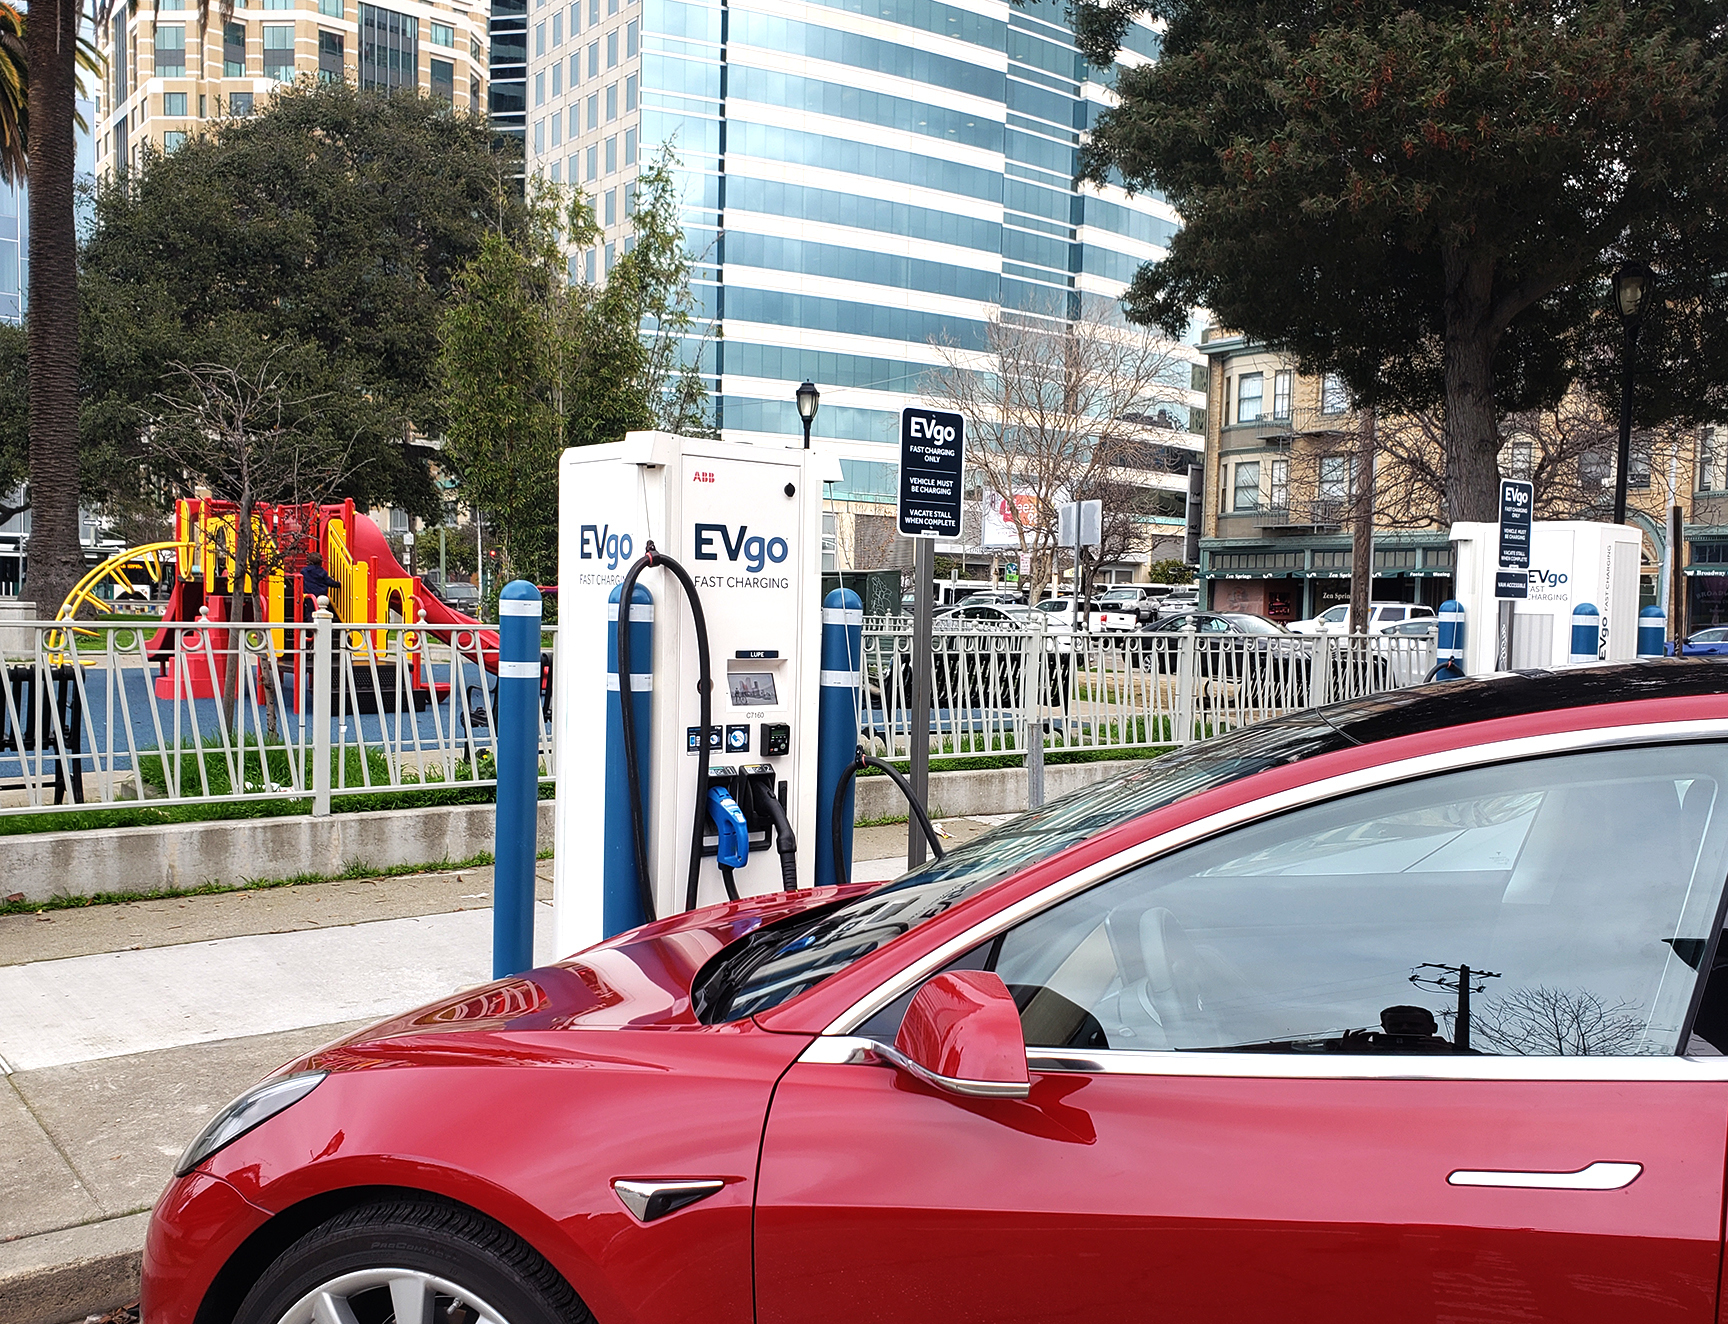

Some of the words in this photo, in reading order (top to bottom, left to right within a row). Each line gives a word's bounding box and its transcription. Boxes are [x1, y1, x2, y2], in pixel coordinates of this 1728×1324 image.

[910, 417, 955, 445] EVgo
[909, 445, 924, 453] FAST
[925, 447, 955, 457] CHARGING
[924, 455, 940, 463] ONLY
[693, 471, 715, 483] ABB
[909, 477, 935, 486] VEHICLE
[936, 480, 953, 488] MUST
[911, 485, 919, 493] BE
[920, 486, 952, 496] CHARGING
[1505, 486, 1528, 506] EVgo
[909, 509, 933, 518] VACATE
[934, 510, 951, 519] STALL
[905, 517, 923, 525] WHEN
[924, 518, 956, 527] COMPLETE
[580, 524, 633, 570] EVgo
[695, 523, 788, 573] EVgo
[579, 574, 595, 585] FAST
[596, 575, 626, 585] CHARGI
[694, 576, 724, 588] FAST
[727, 577, 789, 589] CHARGING
[1528, 570, 1568, 588] EVgo
[1599, 617, 1609, 660] EVgo
